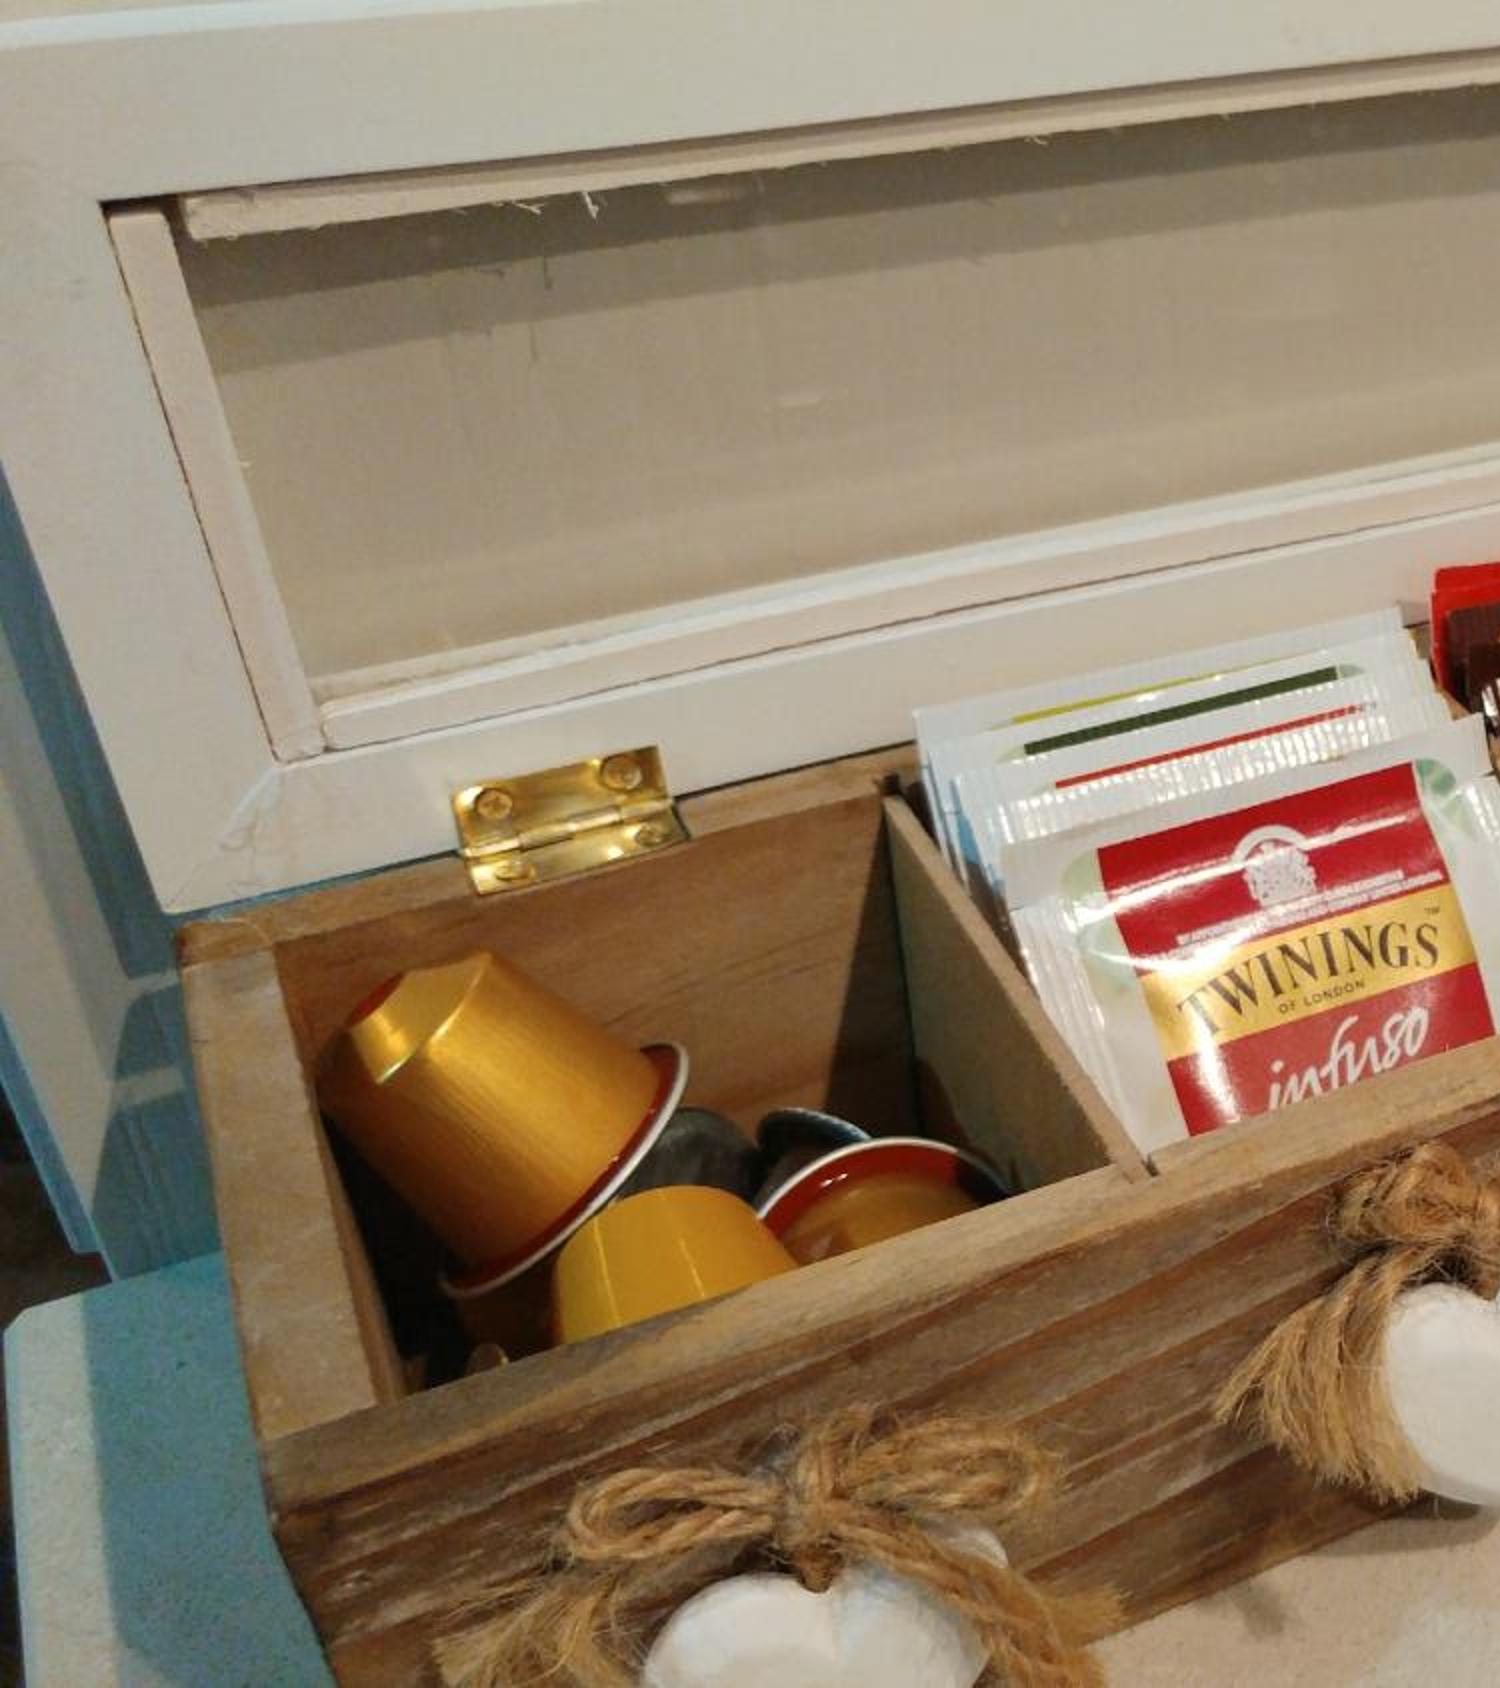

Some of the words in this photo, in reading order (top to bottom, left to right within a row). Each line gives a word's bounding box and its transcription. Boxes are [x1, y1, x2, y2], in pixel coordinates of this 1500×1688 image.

[1177, 921, 1440, 1036] TWININGS
[1279, 1002, 1296, 1014] OF
[1303, 980, 1366, 1006] LONDON
